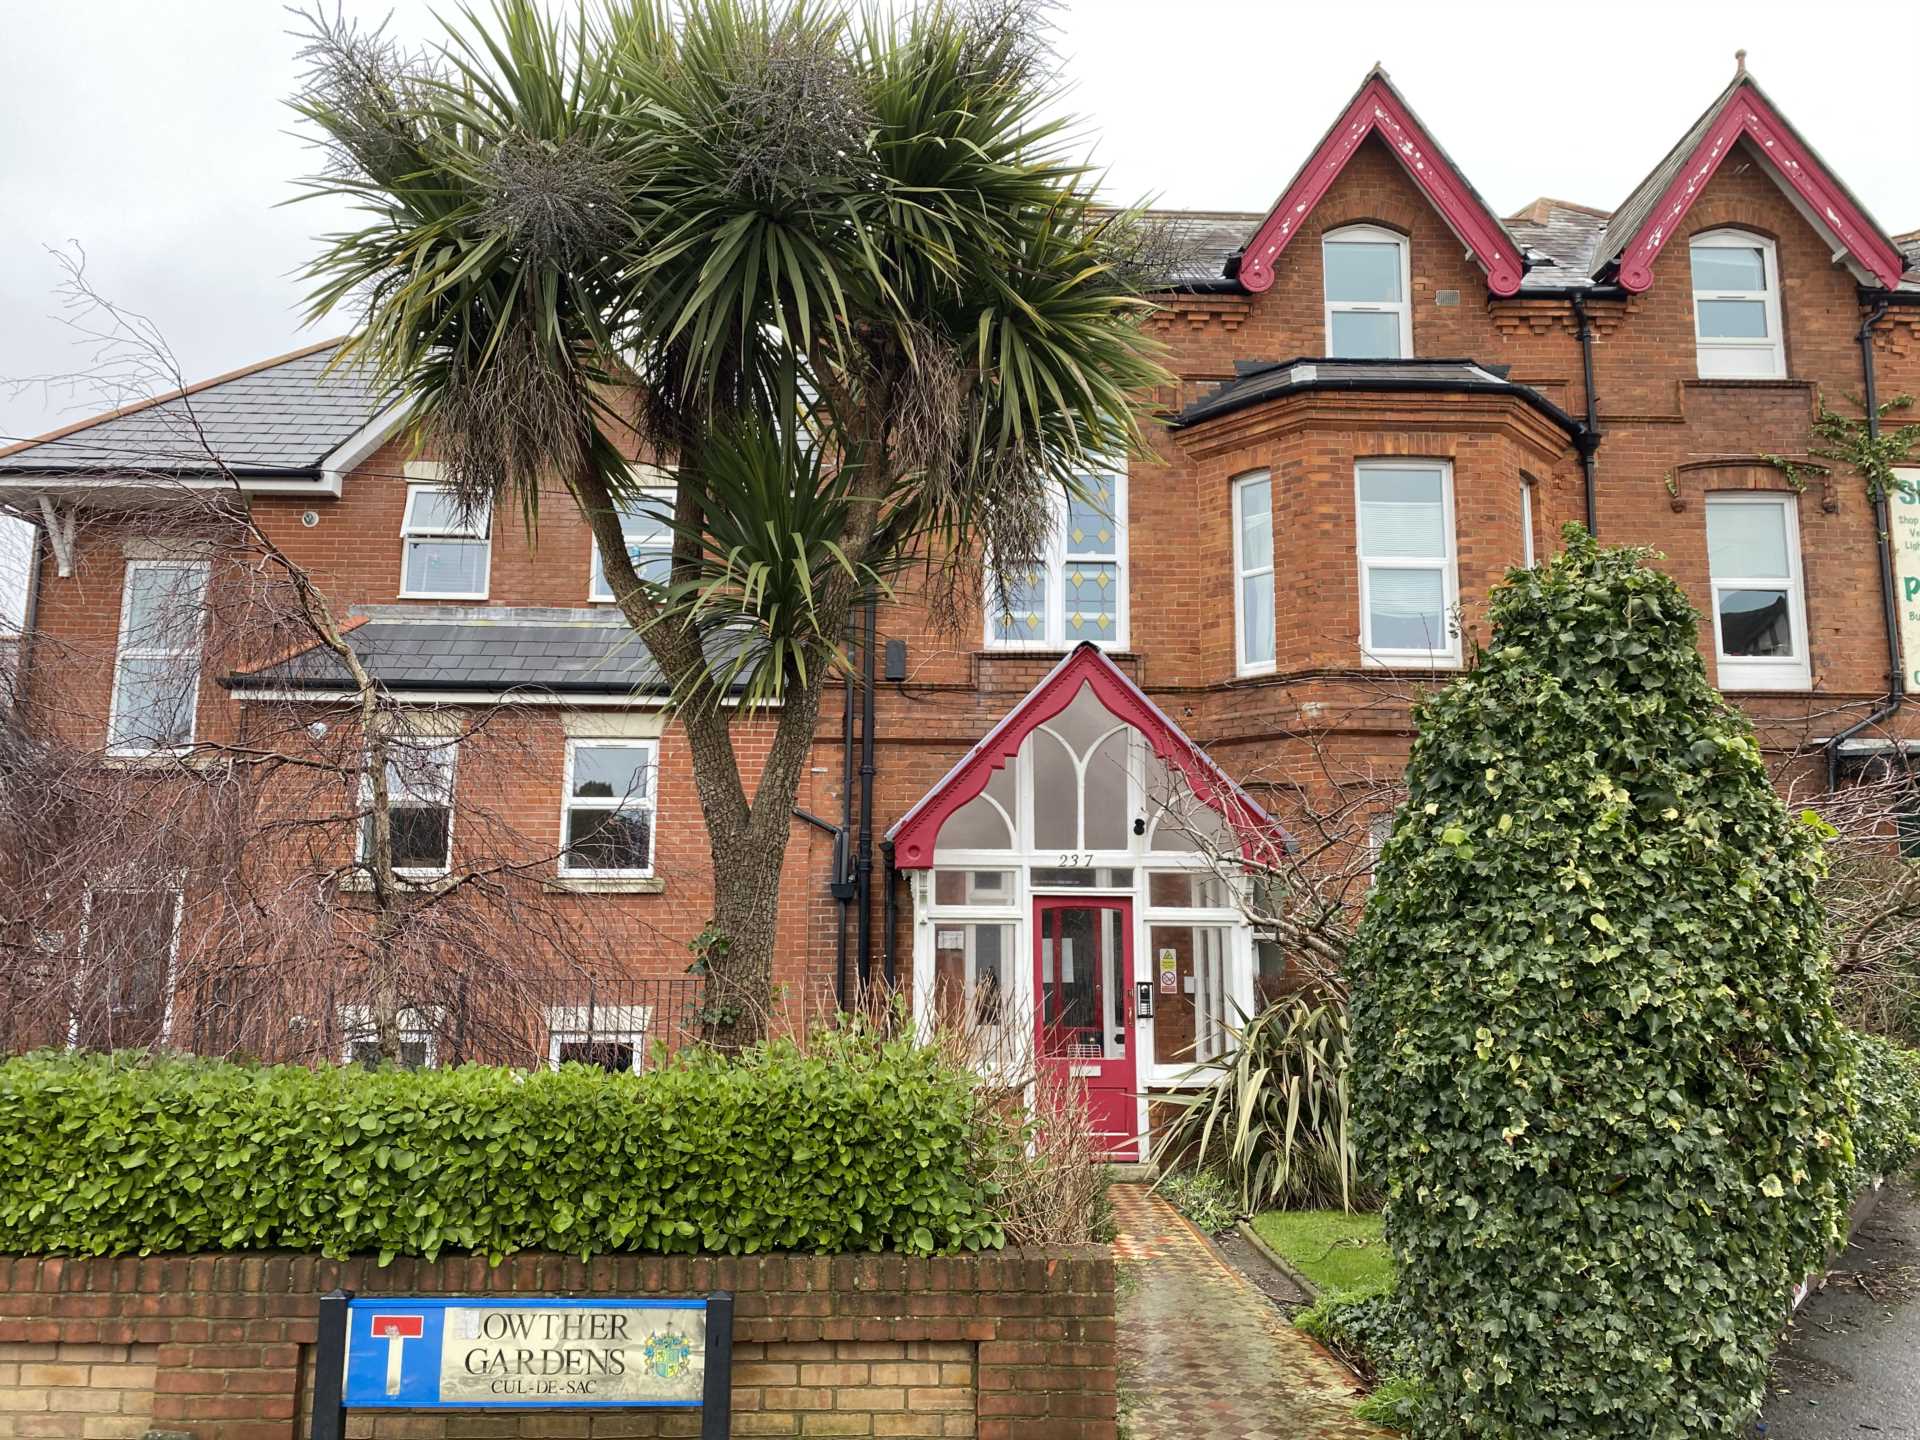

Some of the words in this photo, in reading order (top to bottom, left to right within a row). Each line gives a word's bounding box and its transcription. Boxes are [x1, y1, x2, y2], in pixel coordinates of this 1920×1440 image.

[1057, 854, 1094, 868] 237
[474, 1312, 632, 1341] OWTHER
[464, 1348, 625, 1377] GARDENS
[490, 1379, 597, 1395] CUL-DE-SAC
